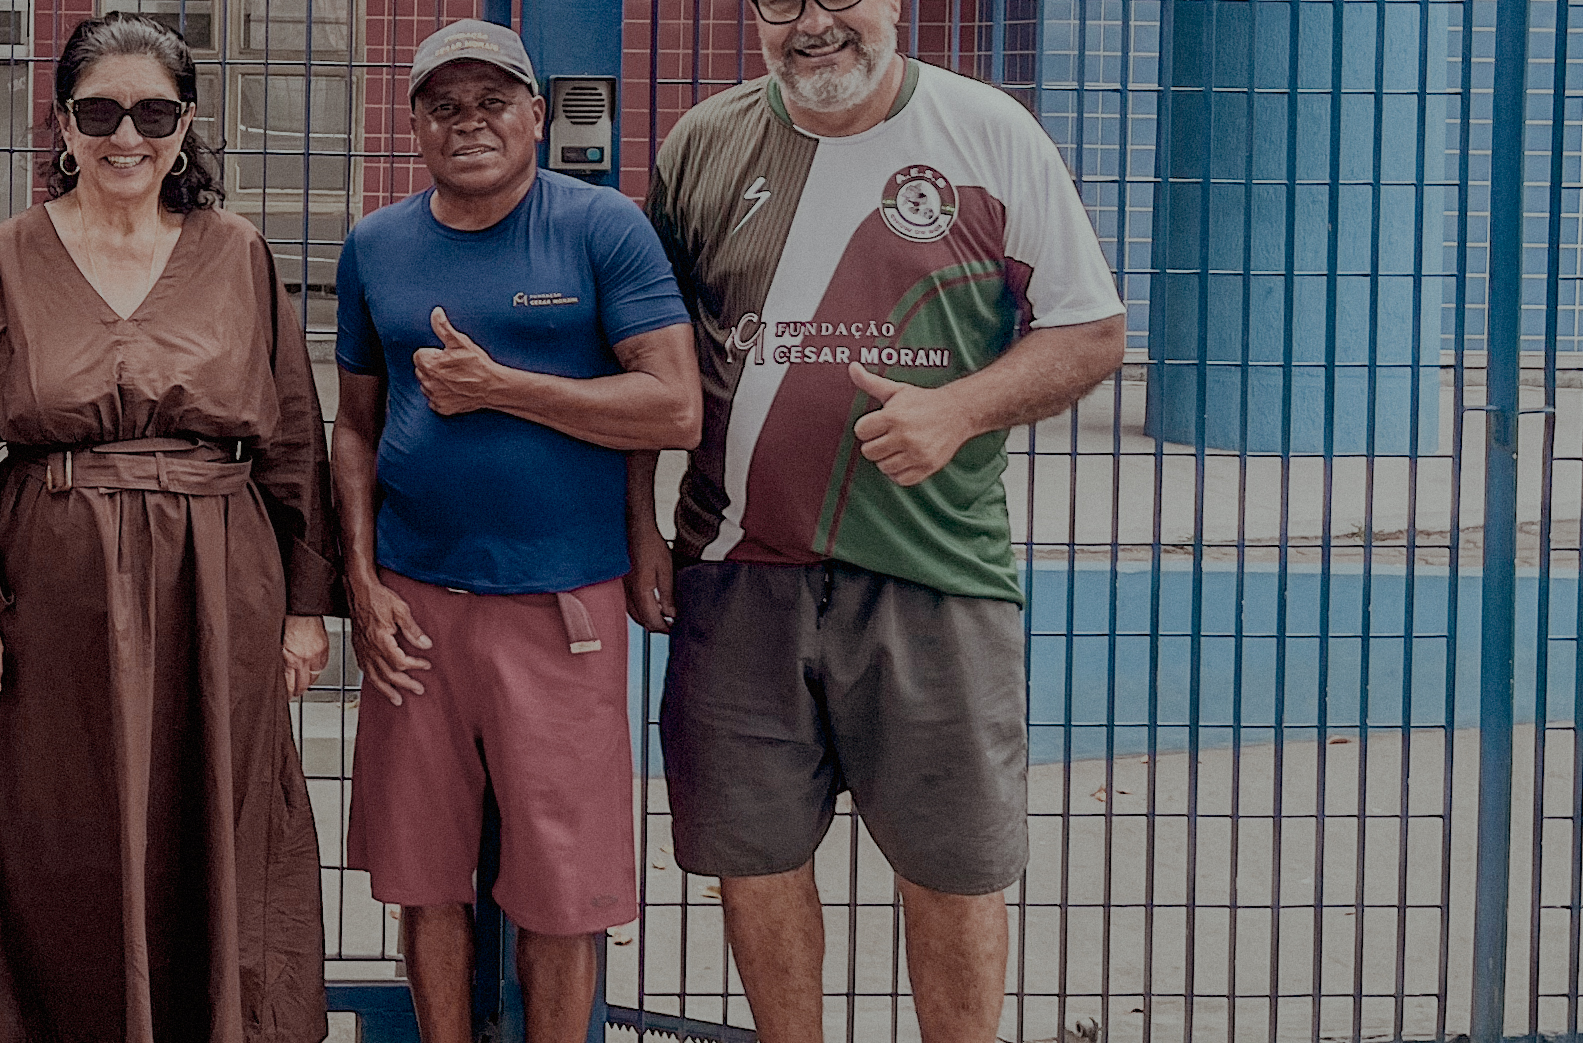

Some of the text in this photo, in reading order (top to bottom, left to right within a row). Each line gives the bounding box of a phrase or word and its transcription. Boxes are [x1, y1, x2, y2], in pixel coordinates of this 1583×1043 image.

[775, 321, 895, 339] FUNDAÇÃO
[773, 345, 950, 367] CESAR MORANI
